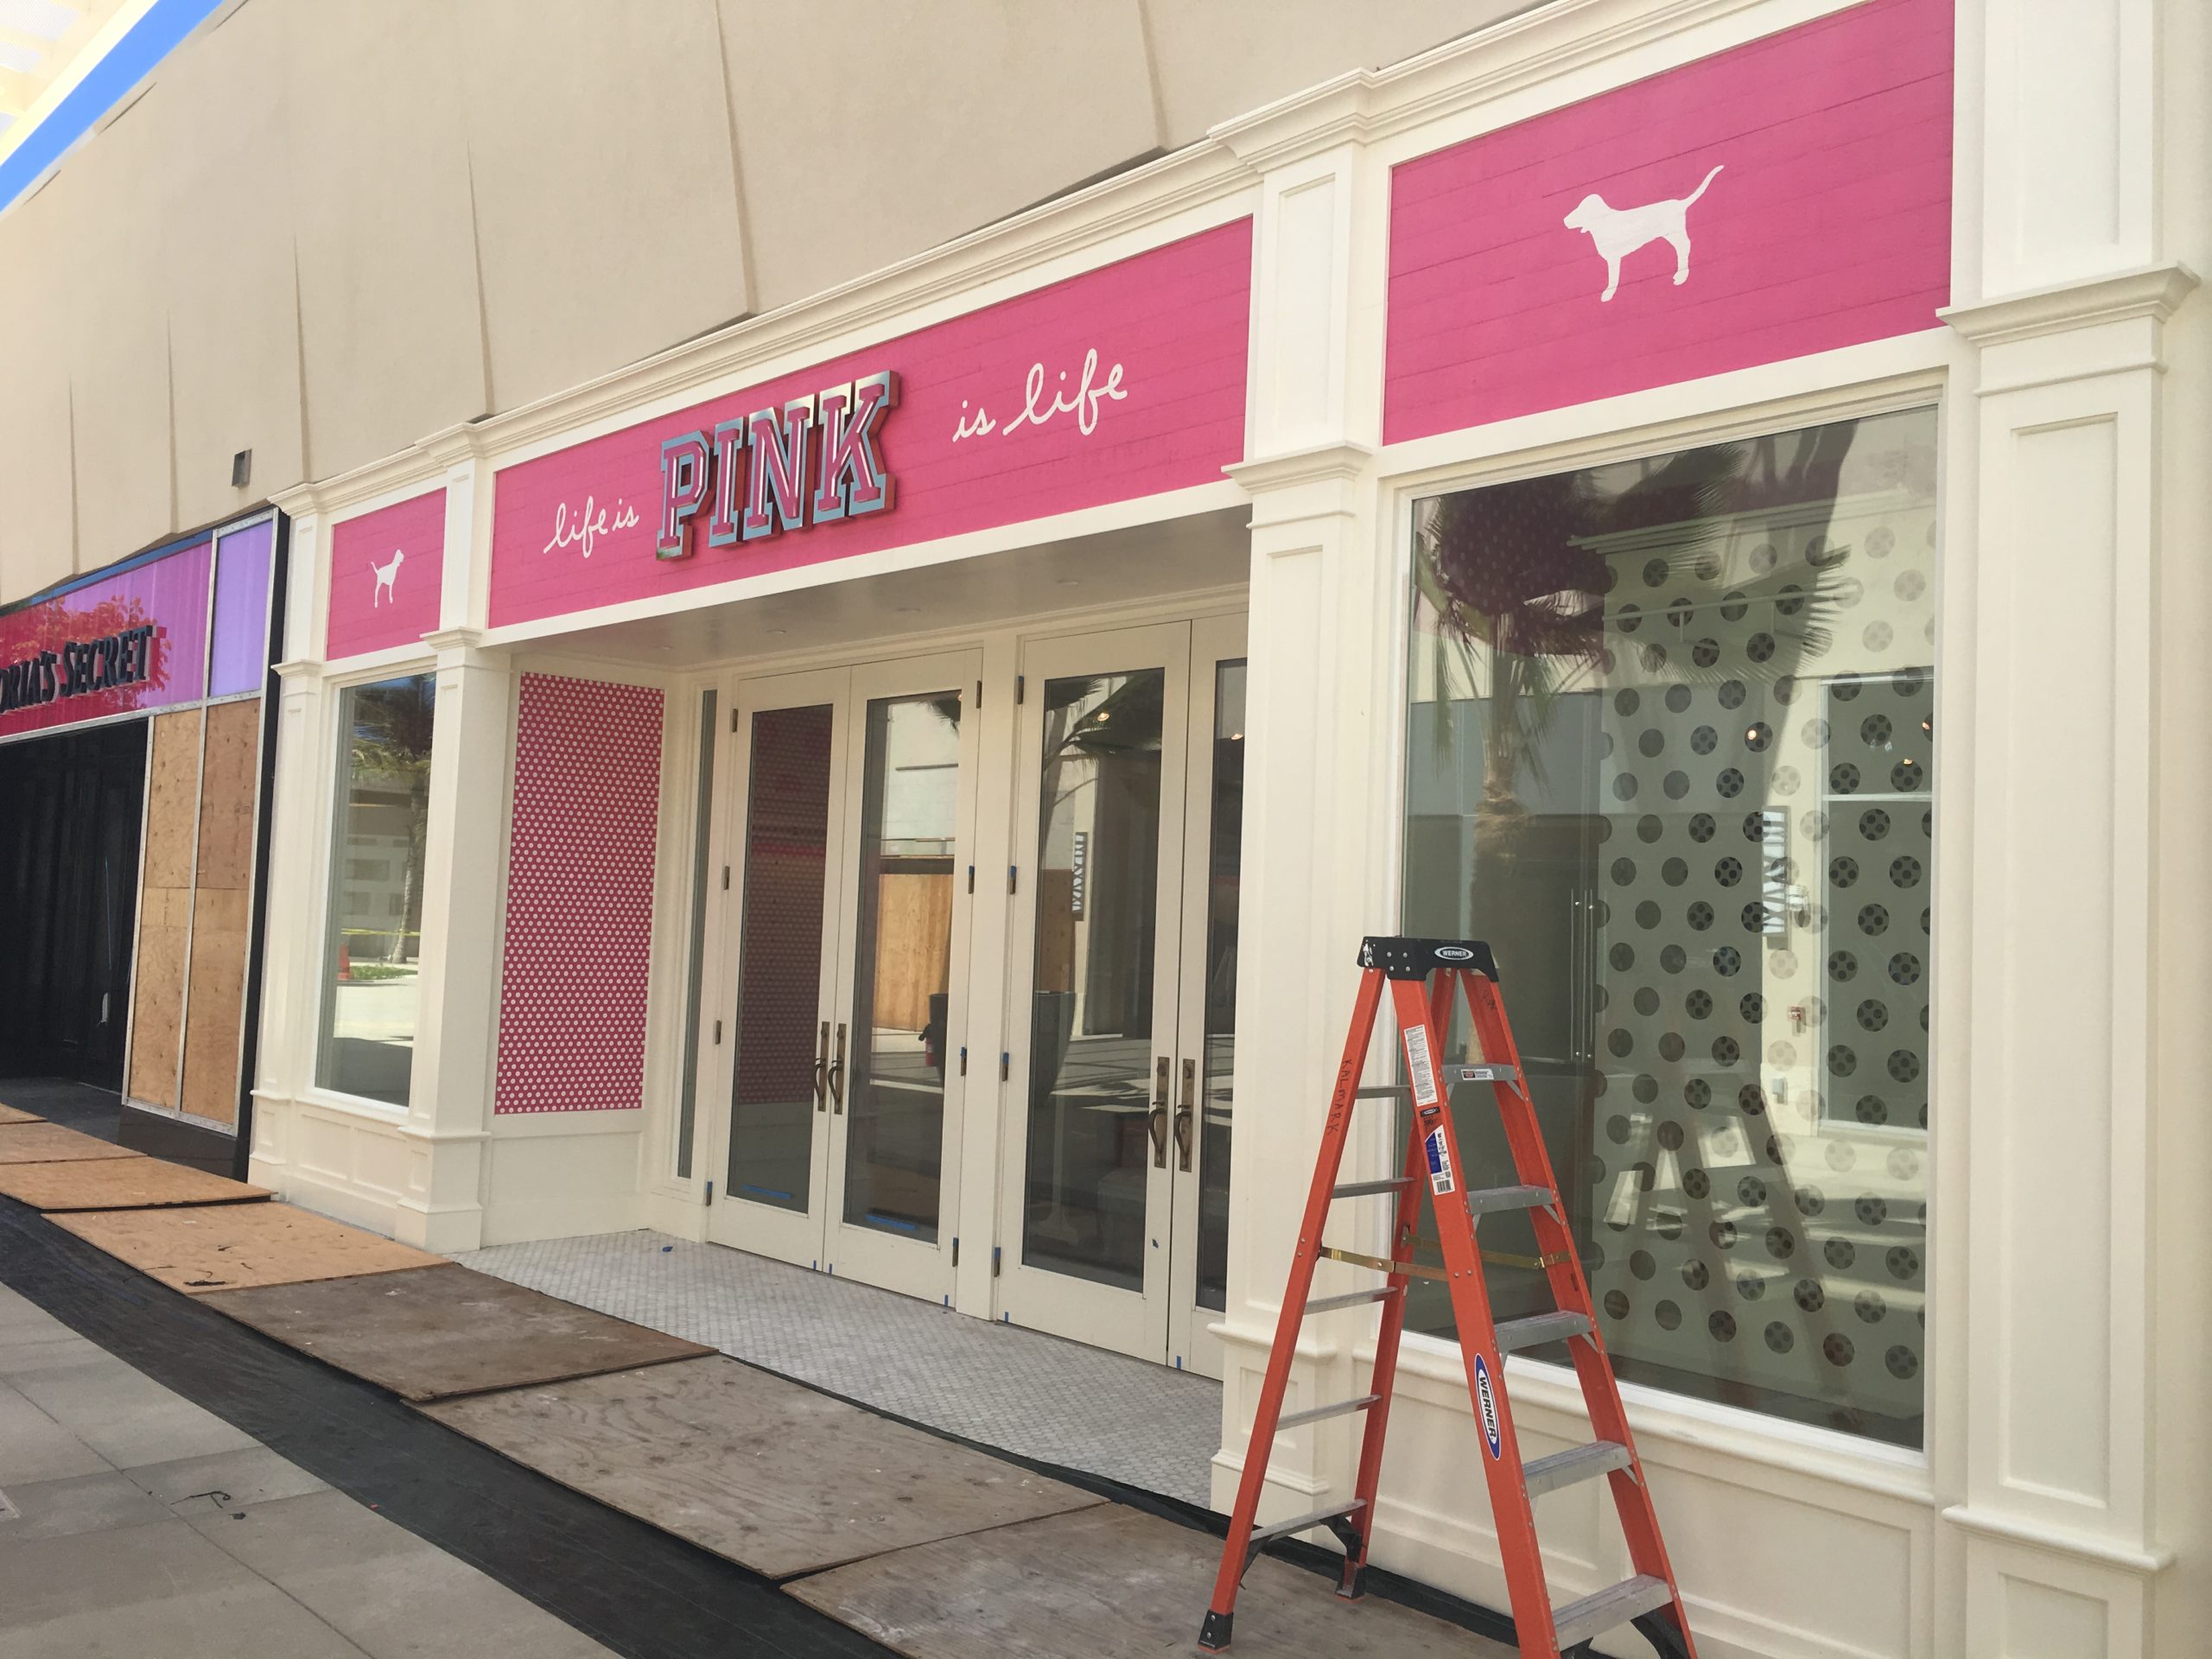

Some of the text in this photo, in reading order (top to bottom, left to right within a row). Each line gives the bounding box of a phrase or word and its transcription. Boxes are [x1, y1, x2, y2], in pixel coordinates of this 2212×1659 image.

[543, 347, 1128, 561] life is PINK is life
[60, 626, 153, 698] SECRET
[1478, 1376, 1497, 1439] WERNER
